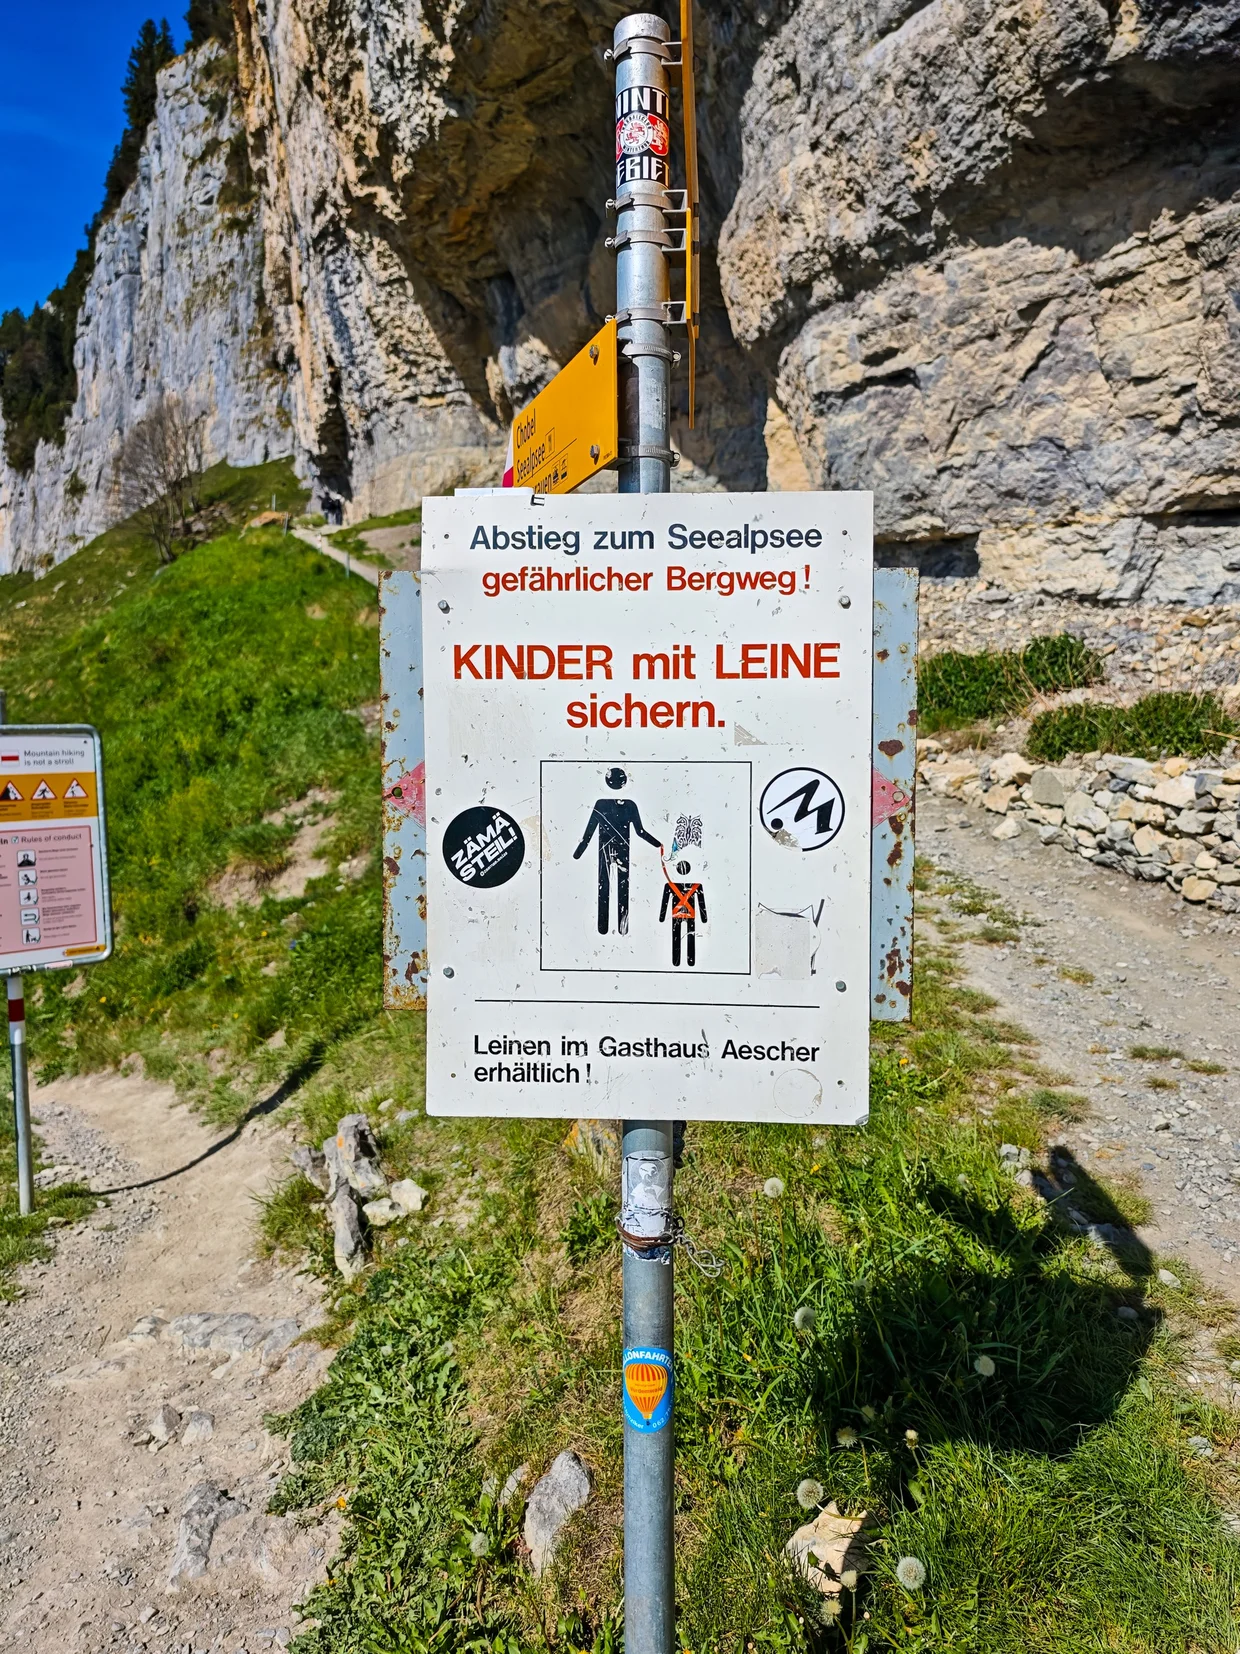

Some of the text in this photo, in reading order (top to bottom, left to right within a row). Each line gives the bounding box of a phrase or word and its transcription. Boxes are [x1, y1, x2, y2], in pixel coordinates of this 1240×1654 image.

[516, 408, 536, 449] Chobel
[516, 441, 546, 484] Seealpsee
[470, 524, 822, 555] Abstieg zum Seealpsee
[482, 566, 653, 597] gefährlicher
[454, 643, 841, 680] KINDER mit LEINE
[566, 693, 726, 728] sichern.
[24, 749, 85, 757] Mountain hiking
[451, 811, 511, 870] ZÄMÄ
[459, 826, 518, 882] STEIL!
[475, 1035, 820, 1062] Leinen im Gasthaus Aescher
